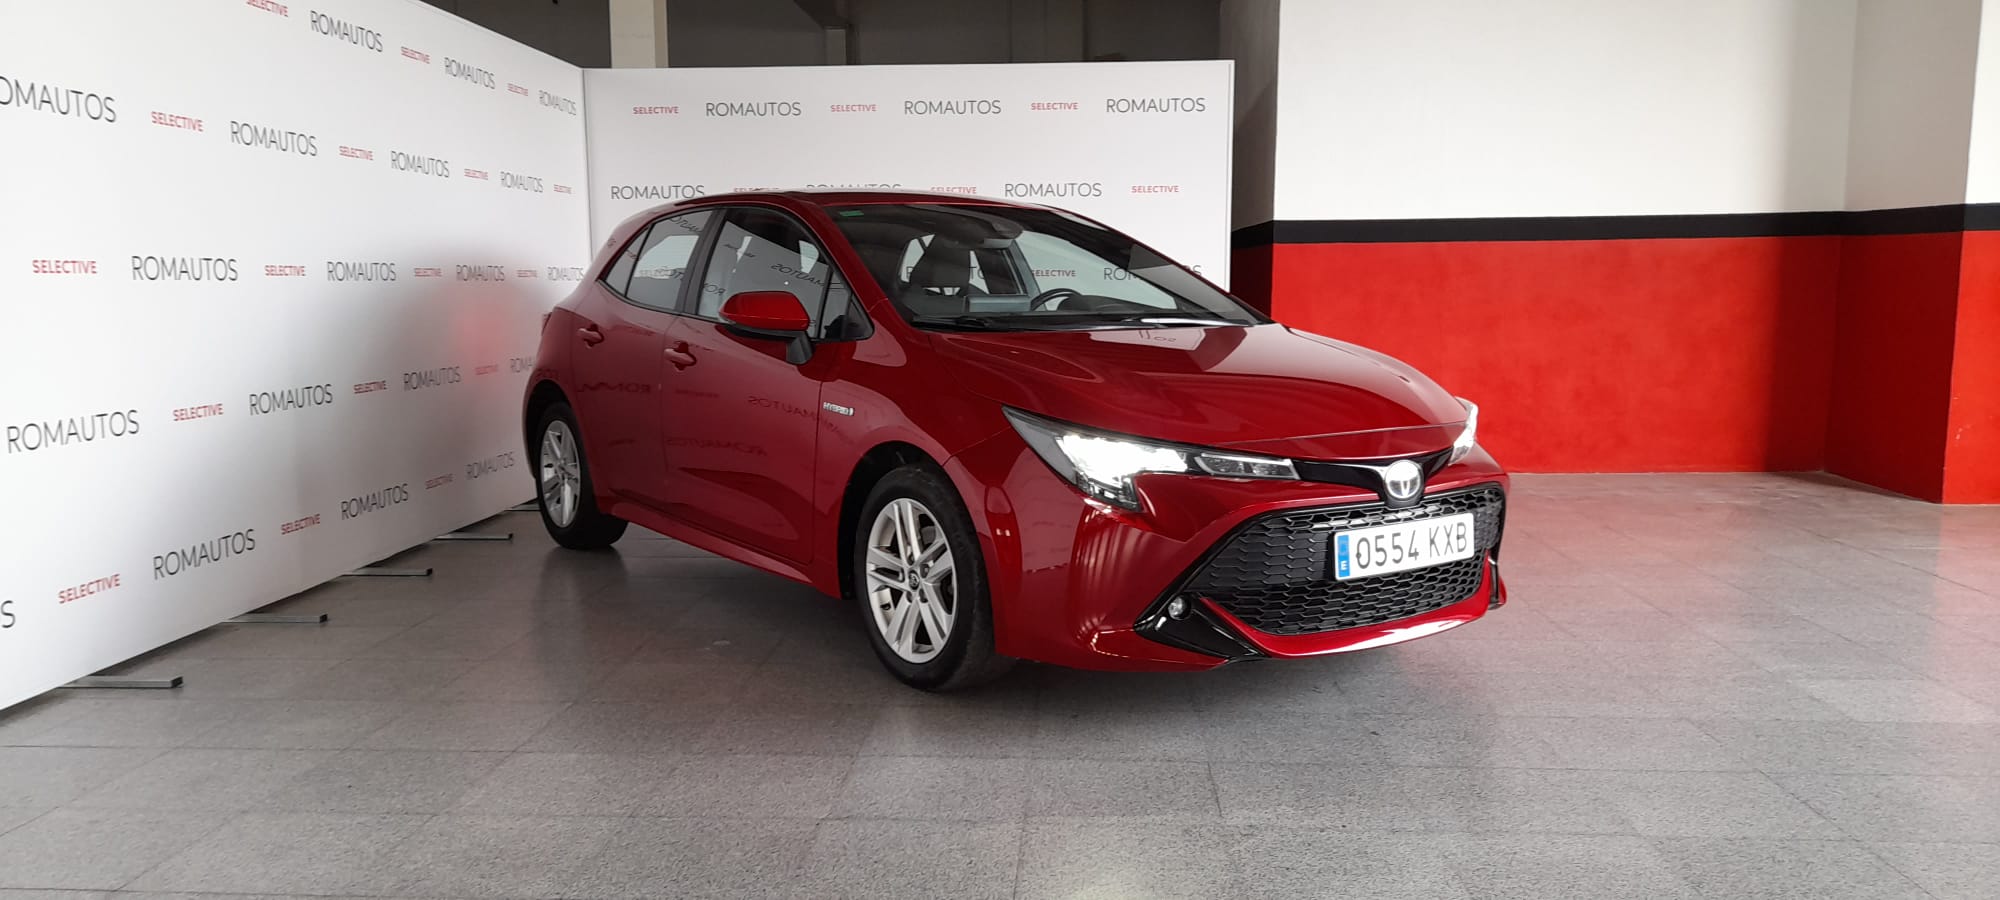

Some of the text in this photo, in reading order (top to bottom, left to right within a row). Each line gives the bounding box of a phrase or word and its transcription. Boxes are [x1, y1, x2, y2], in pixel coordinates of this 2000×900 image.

[310, 10, 383, 53] ROMAUTOS
[444, 56, 496, 90] ROMAUTOS
[539, 90, 577, 116] ROMAUTOS
[632, 97, 1206, 117] SELECTIVE ROMAUTOS SELECTIVE ROMAUTOS SELECTIVE ROMAUTOS
[0, 76, 117, 123] OMAUTOS
[151, 111, 204, 132] SELECTIVE
[230, 120, 318, 157] ROMAUTOS
[391, 150, 450, 178] ROMAUTOS
[501, 171, 544, 194] ROMAUTOS
[610, 185, 705, 200] ROMAUTOS
[1004, 183, 1102, 197] ROMAUTOS
[1131, 185, 1179, 194] SELECTIVE
[32, 260, 97, 274] SELECTIVE
[132, 256, 238, 281] ROMAUTOS
[264, 265, 306, 276] SELECTIVE
[327, 262, 397, 282] ROMAUTOS
[456, 264, 505, 281] ROMAUTOS
[7, 409, 140, 453] ROMAUTOS
[173, 403, 224, 422] SELECTIVE
[249, 384, 333, 416] ROMAUTOS
[403, 366, 461, 391] ROMAUTOS
[58, 574, 121, 604] SELECTIVE
[153, 528, 256, 580] ROMAUTOS
[281, 514, 321, 535] SELECTIVE
[341, 483, 409, 520] ROMAUTOS
[1356, 522, 1467, 569] 0554 KXB
[1341, 561, 1348, 570] E
